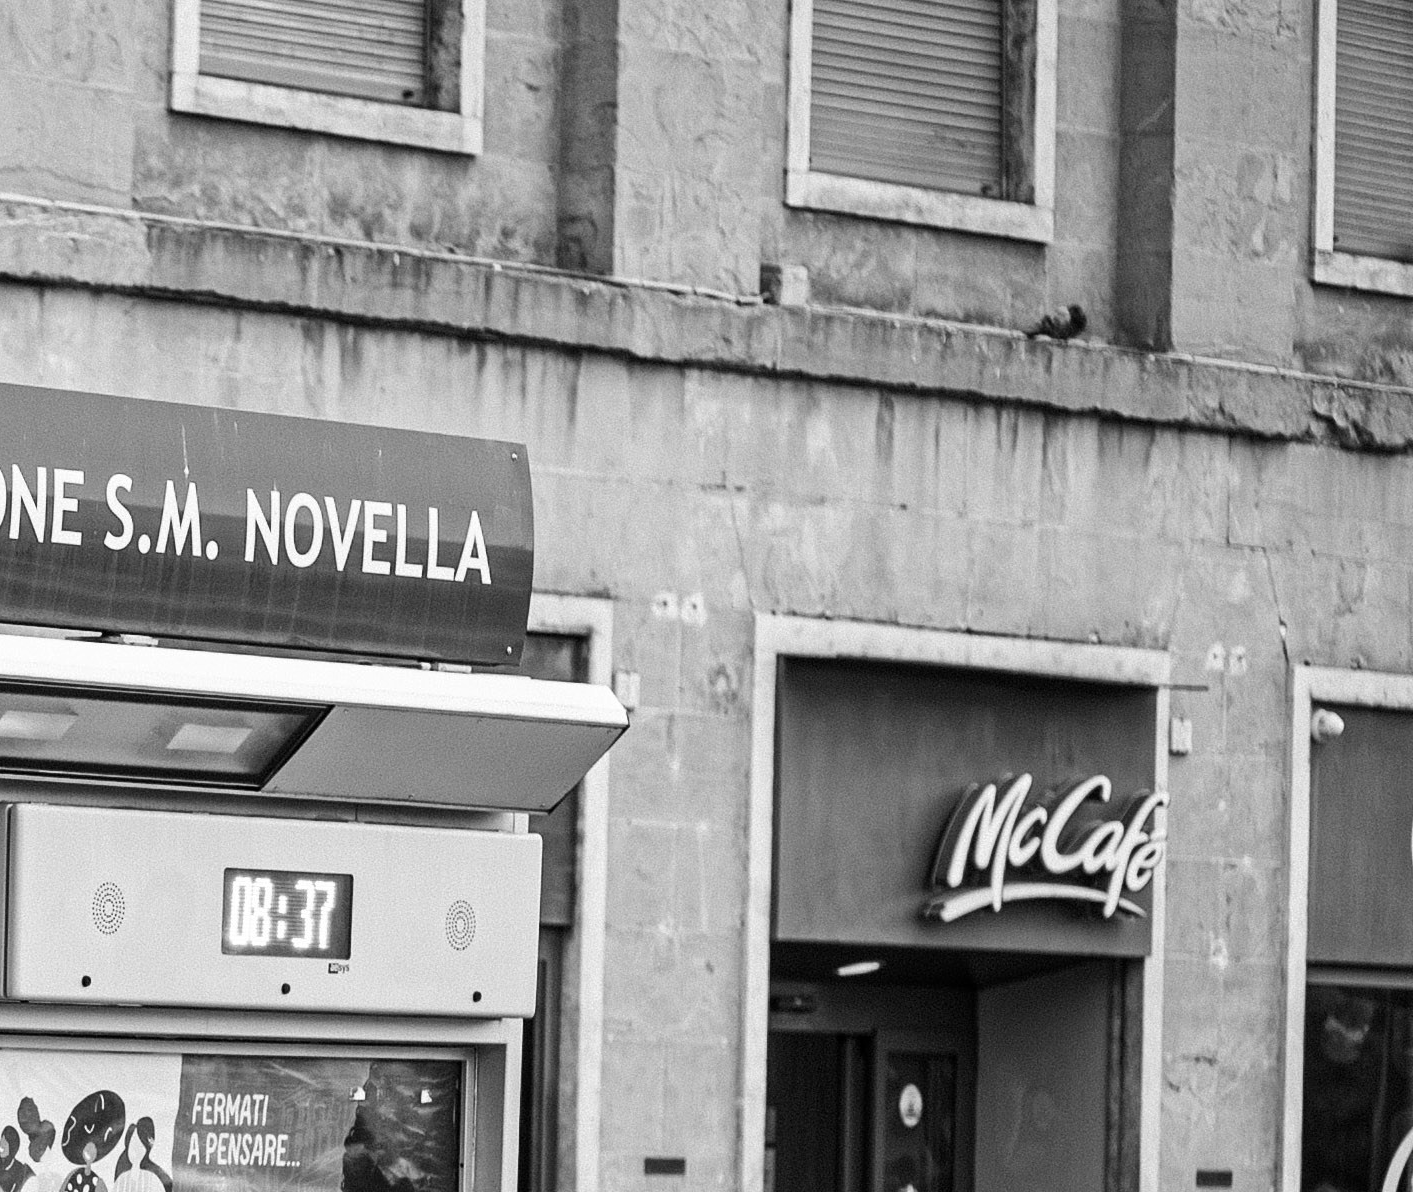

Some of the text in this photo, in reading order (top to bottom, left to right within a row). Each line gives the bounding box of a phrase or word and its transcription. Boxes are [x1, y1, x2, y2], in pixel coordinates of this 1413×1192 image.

[103, 473, 219, 562] S.M.
[244, 487, 492, 585] NOVELLA
[947, 772, 1170, 919] McCafé
[229, 876, 336, 950] 08:37
[192, 1092, 269, 1126] FERMATI
[187, 1132, 300, 1167] A PENSARE...
